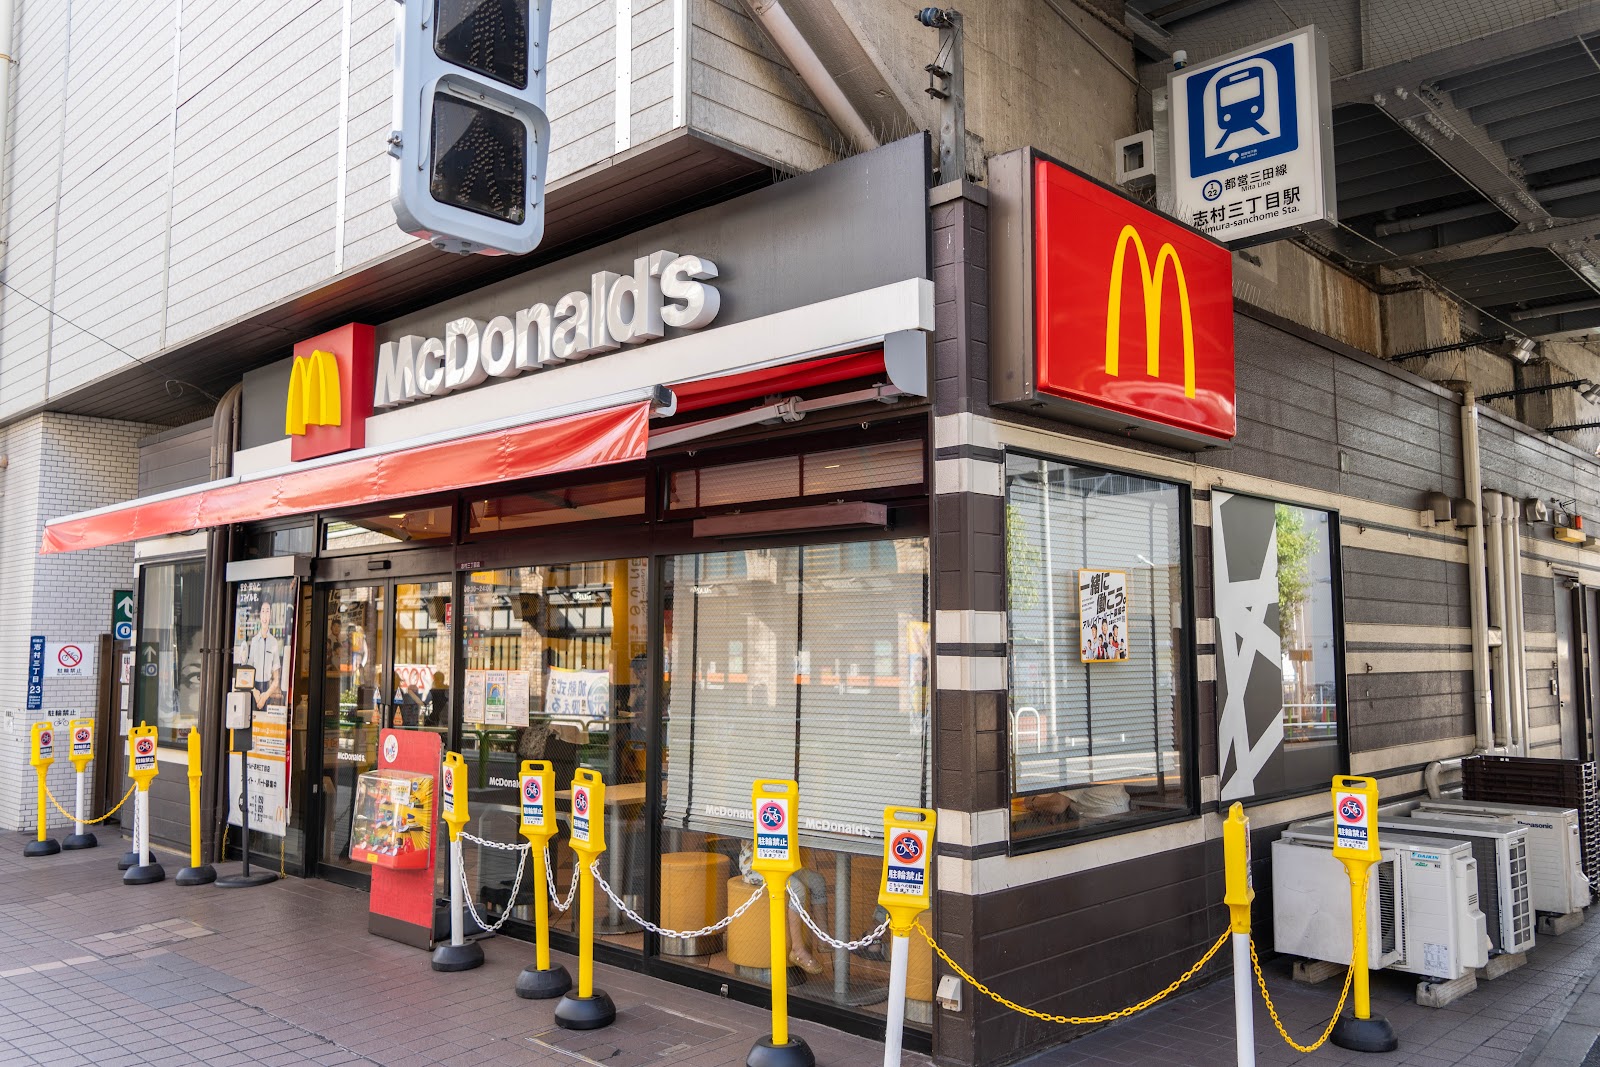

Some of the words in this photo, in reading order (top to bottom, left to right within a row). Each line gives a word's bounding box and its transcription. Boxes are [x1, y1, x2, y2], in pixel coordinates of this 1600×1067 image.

[1224, 163, 1288, 191] 都営三田線
[1207, 189, 1218, 197] 22
[1241, 184, 1256, 193] Mita
[1257, 180, 1271, 189] Line
[1192, 186, 1301, 228] 志村三丁目駅
[1196, 209, 1280, 235] himura-sanchome
[1281, 204, 1300, 215] Sta.
[374, 250, 721, 408] McDonald's
[1080, 572, 1110, 596] 一緒に
[32, 644, 41, 683] 志村三丁目
[30, 685, 42, 694] 23
[47, 709, 77, 717] 駐輪禁止
[804, 817, 872, 838] McDonald's
[757, 836, 788, 847] 駐輪禁止
[1417, 853, 1439, 861] DAIKIN
[888, 869, 924, 881] 駐輪禁止
